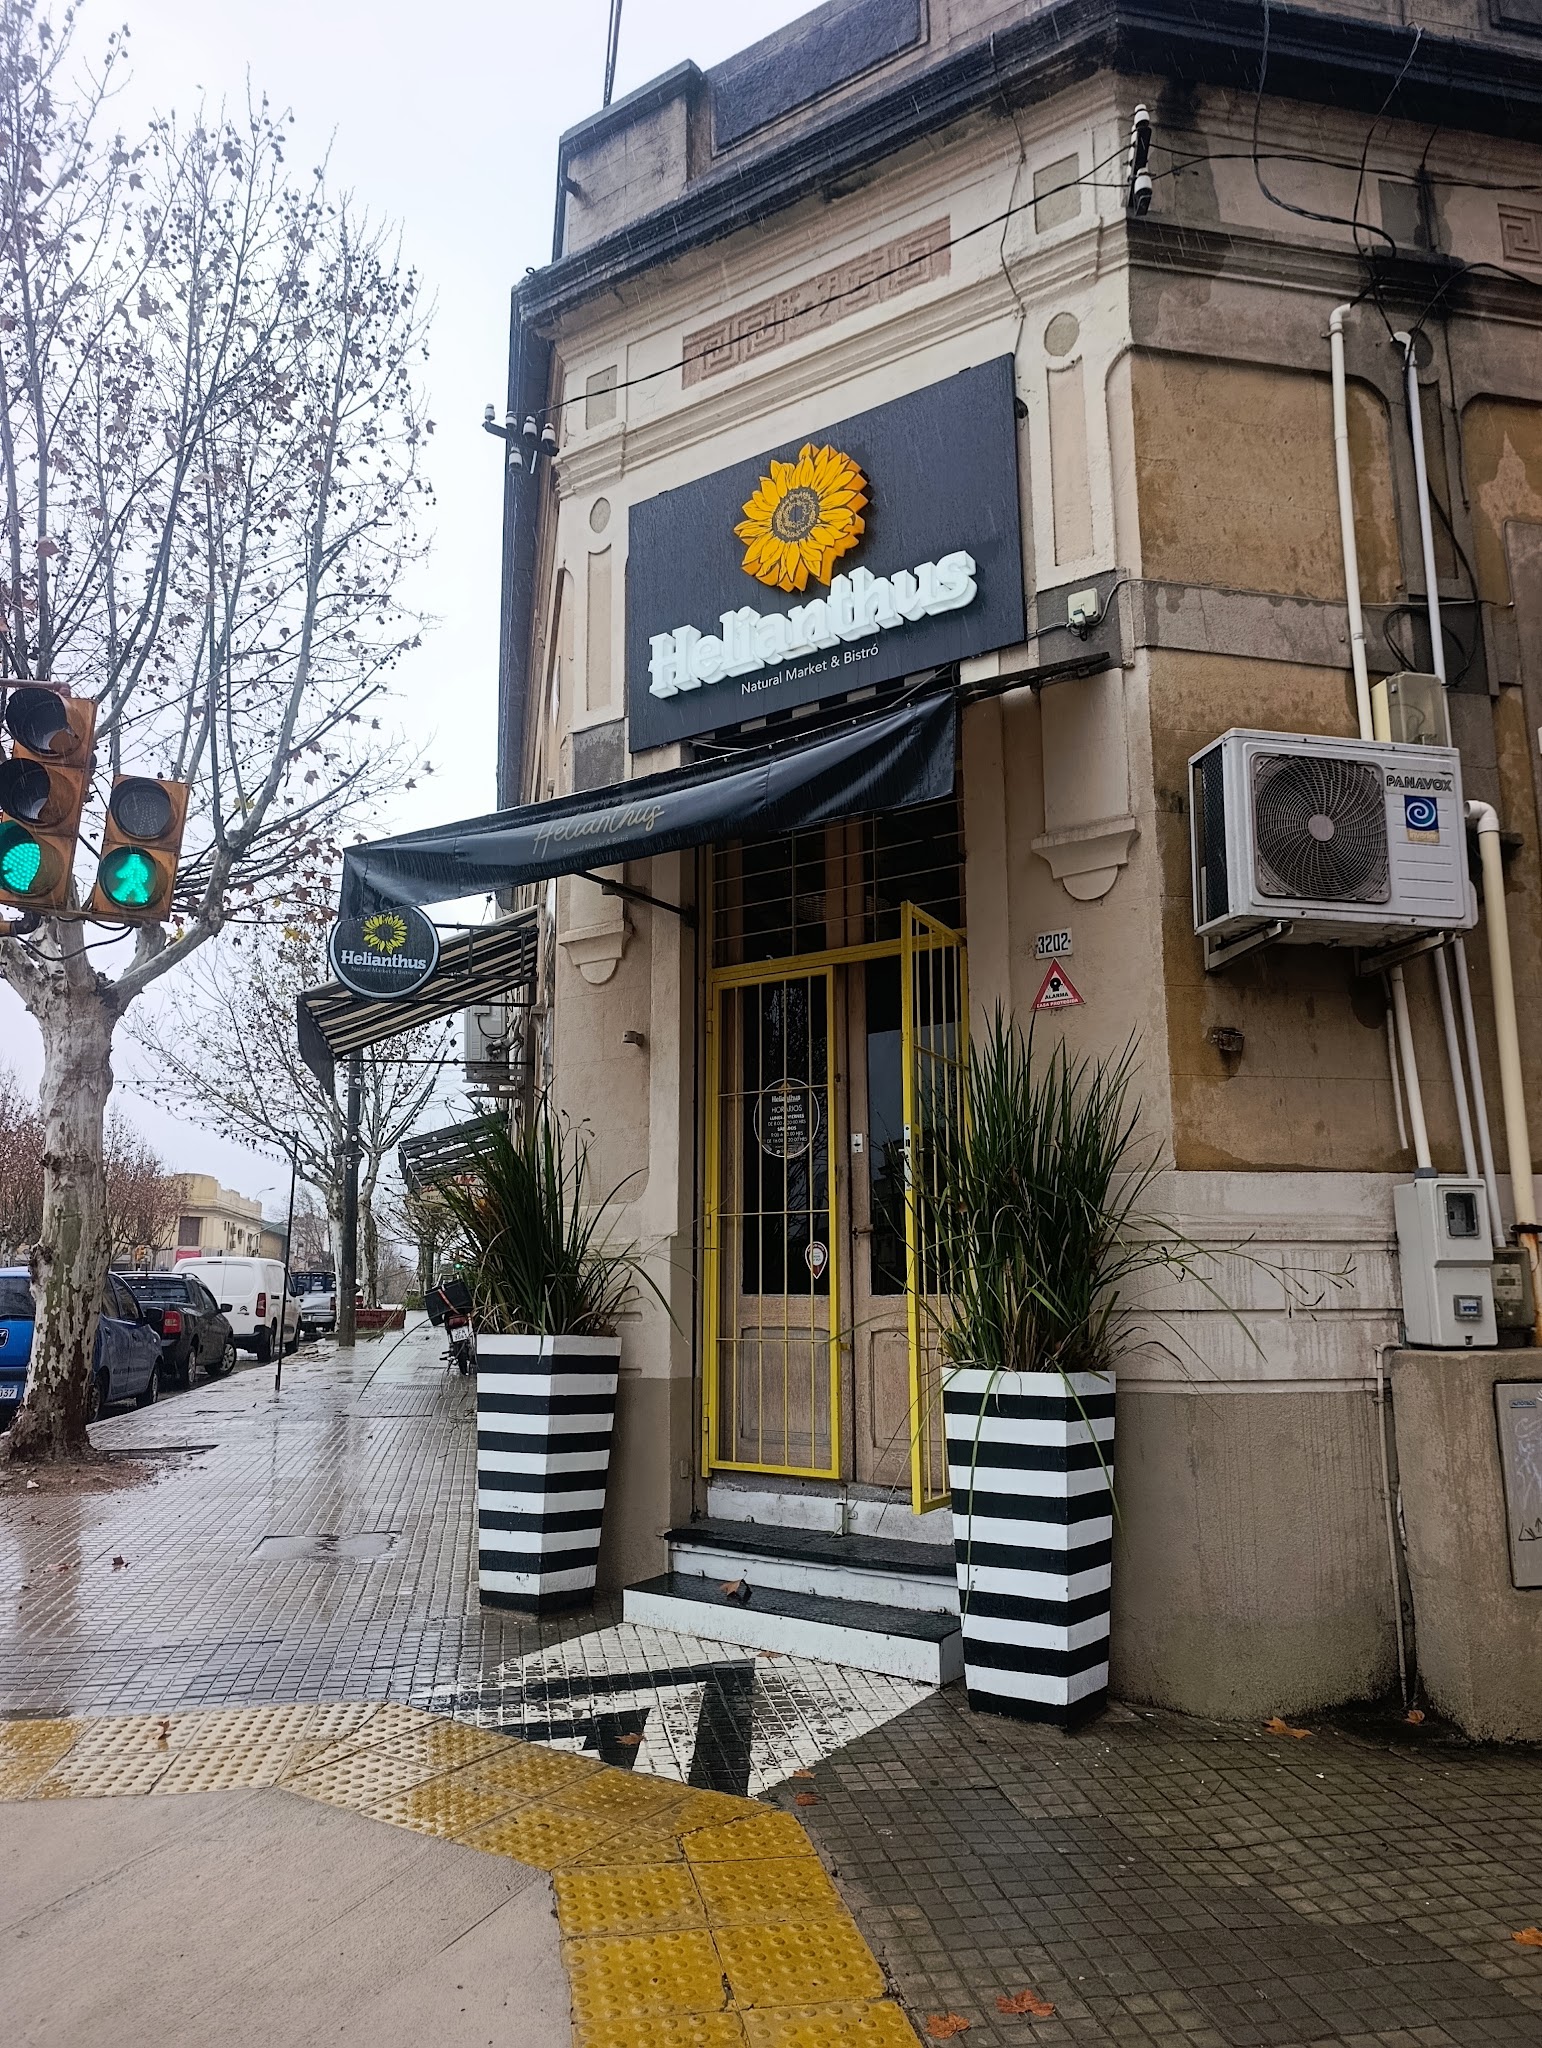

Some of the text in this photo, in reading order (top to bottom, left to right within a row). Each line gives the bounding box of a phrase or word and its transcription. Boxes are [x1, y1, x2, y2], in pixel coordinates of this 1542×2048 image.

[648, 550, 977, 698] Helianthus
[741, 643, 879, 695] Natural Market & Bistró
[1386, 774, 1453, 792] PANAVOX
[533, 800, 665, 858] Helianthus
[1038, 932, 1068, 954] 3202
[341, 949, 426, 970] Helianthus
[1045, 992, 1069, 1000] ALARMA
